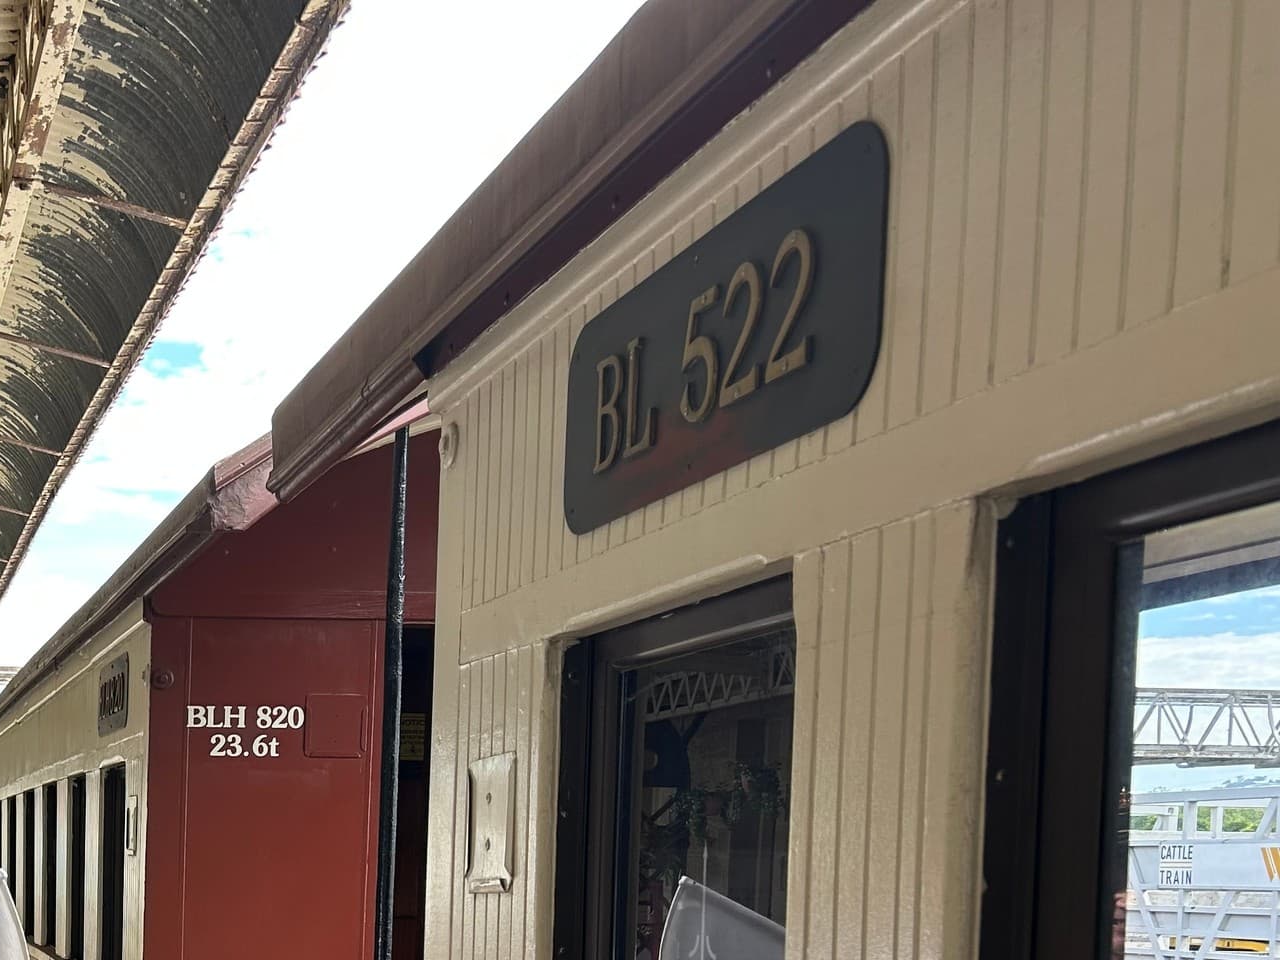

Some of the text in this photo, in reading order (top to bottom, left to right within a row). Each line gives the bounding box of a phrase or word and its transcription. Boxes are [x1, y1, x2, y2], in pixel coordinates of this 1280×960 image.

[593, 226, 817, 475] BL 522
[186, 705, 305, 729] BLH 820
[209, 734, 280, 757] 23.6t
[1160, 845, 1194, 860] CATTLE
[1159, 870, 1192, 885] TRAIN
